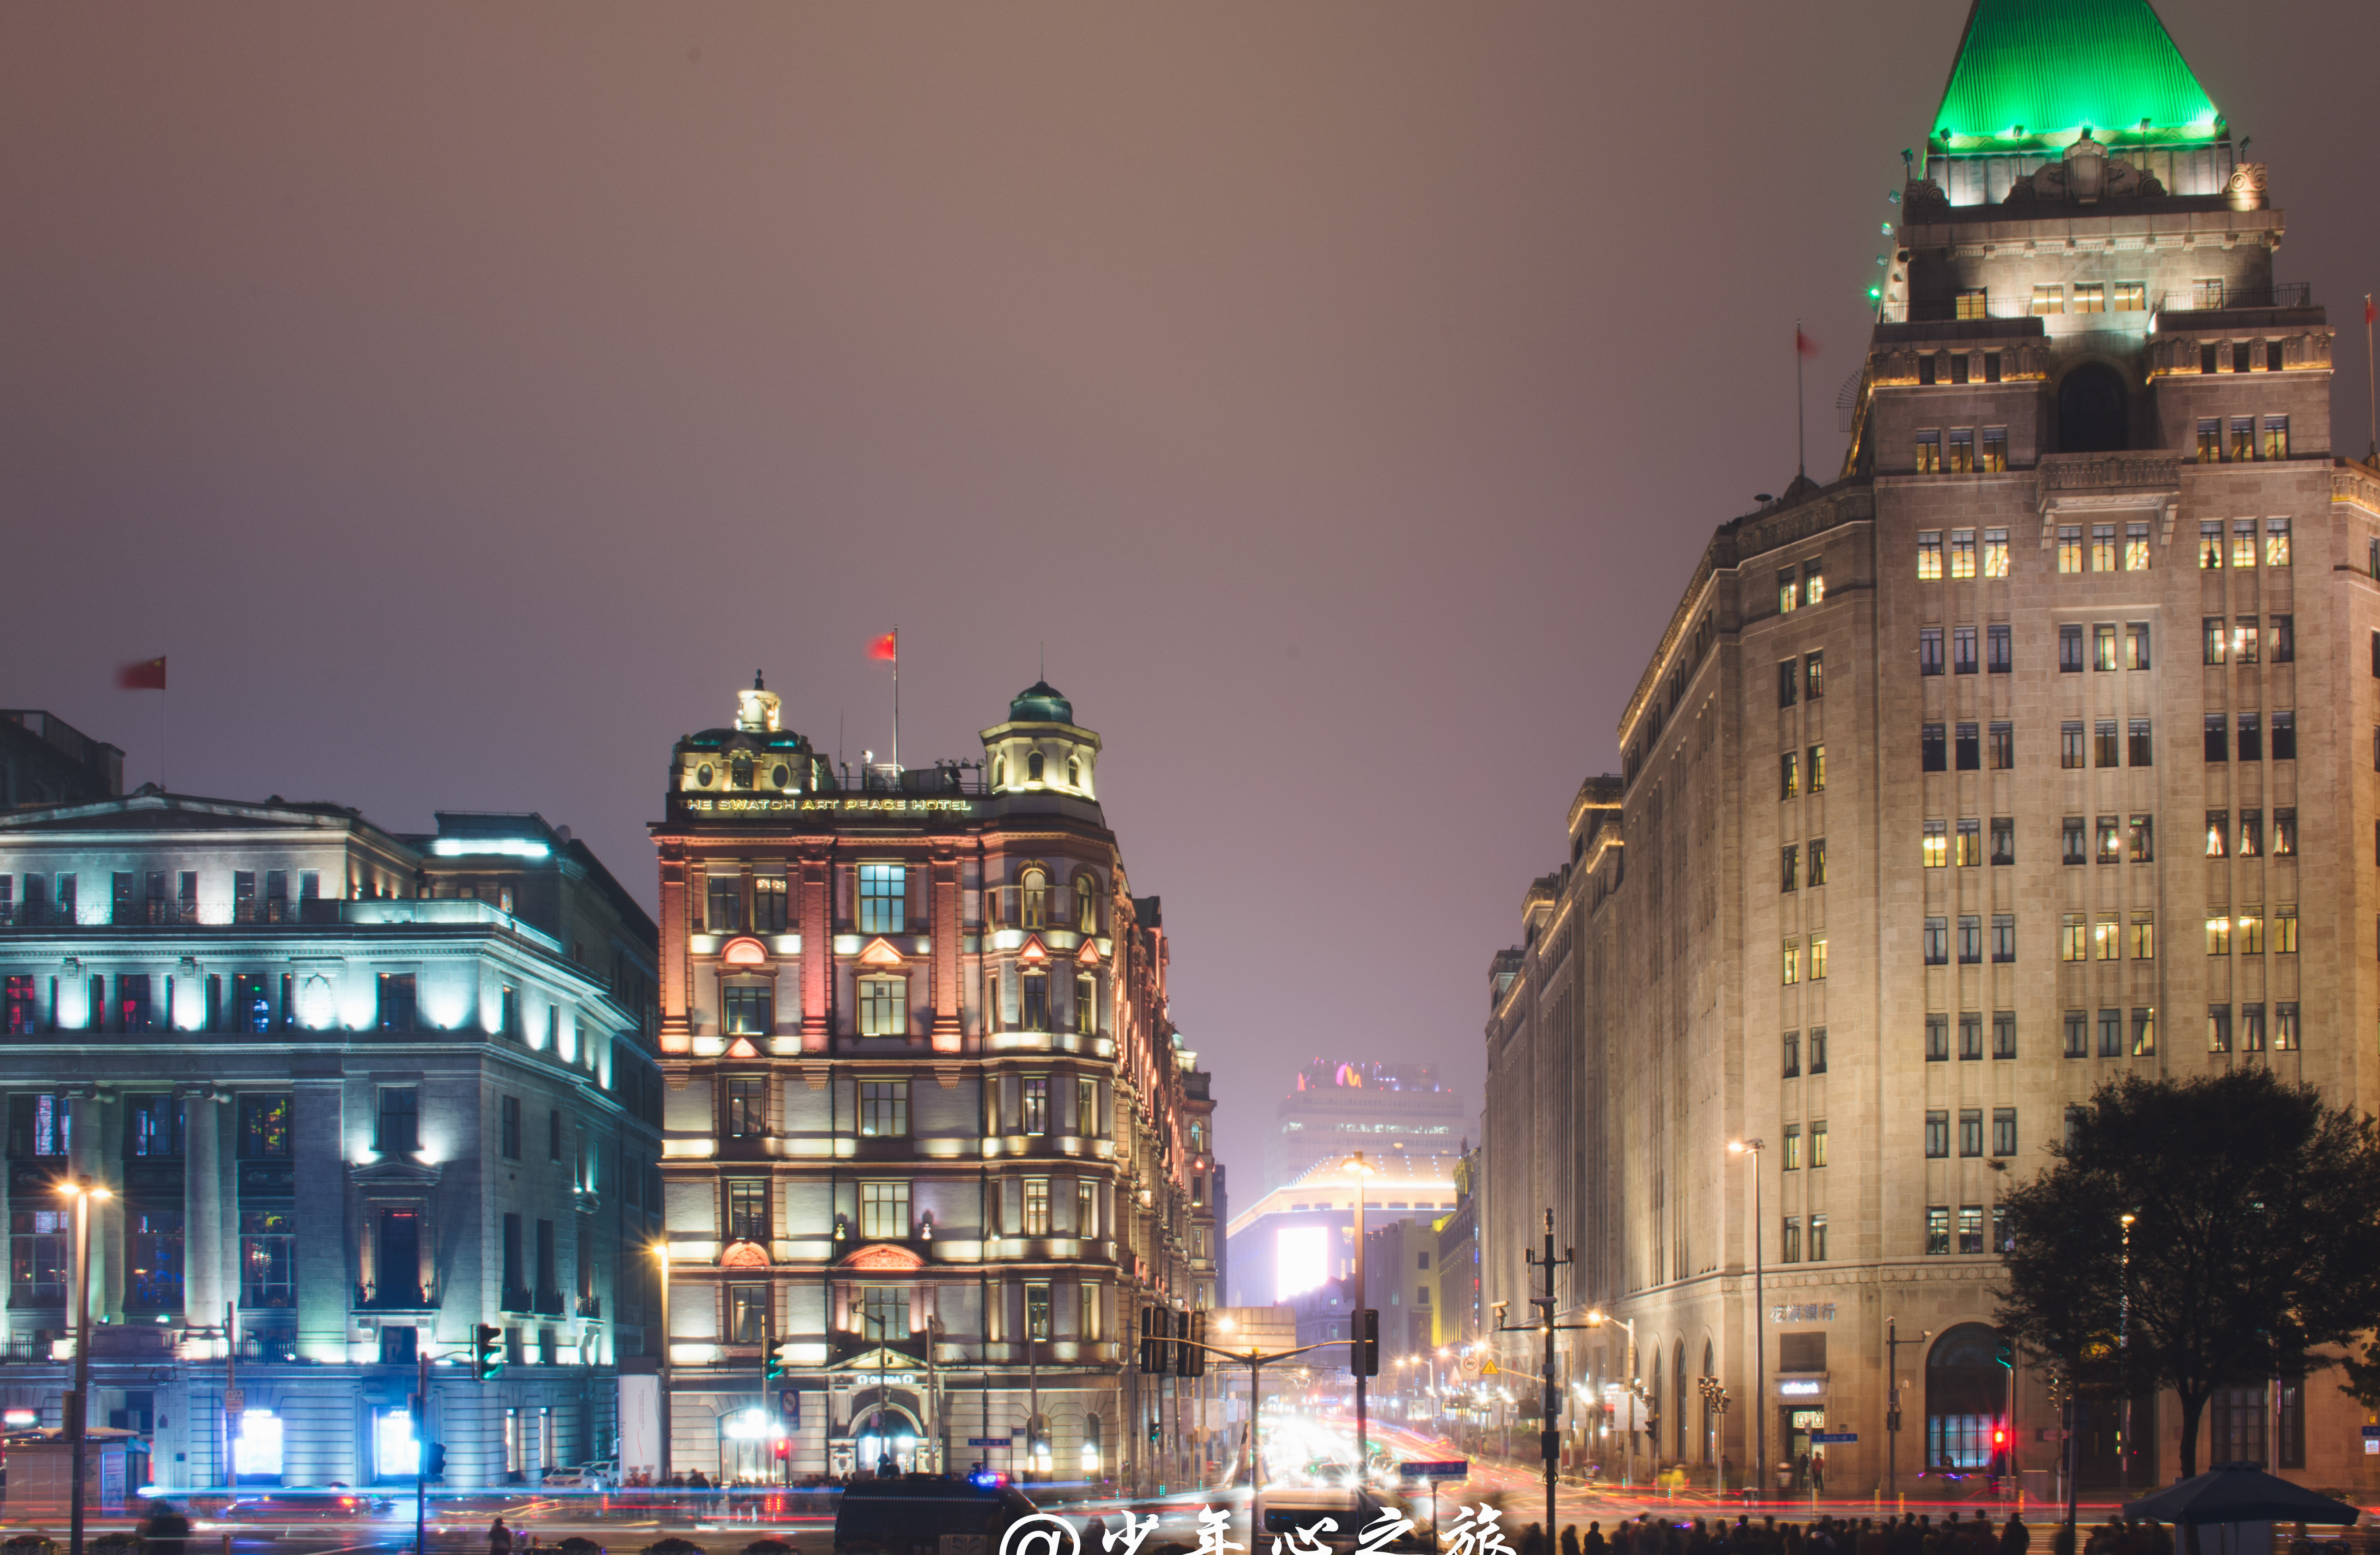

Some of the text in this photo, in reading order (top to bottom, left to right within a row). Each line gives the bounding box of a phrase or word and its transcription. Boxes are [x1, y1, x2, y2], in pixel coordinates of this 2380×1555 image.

[677, 799, 971, 810] THE SWATCH ART PEACE HOTEL
[1770, 1303, 1836, 1323] 花旗银行
[1413, 1464, 1455, 1473] 中山东一路
